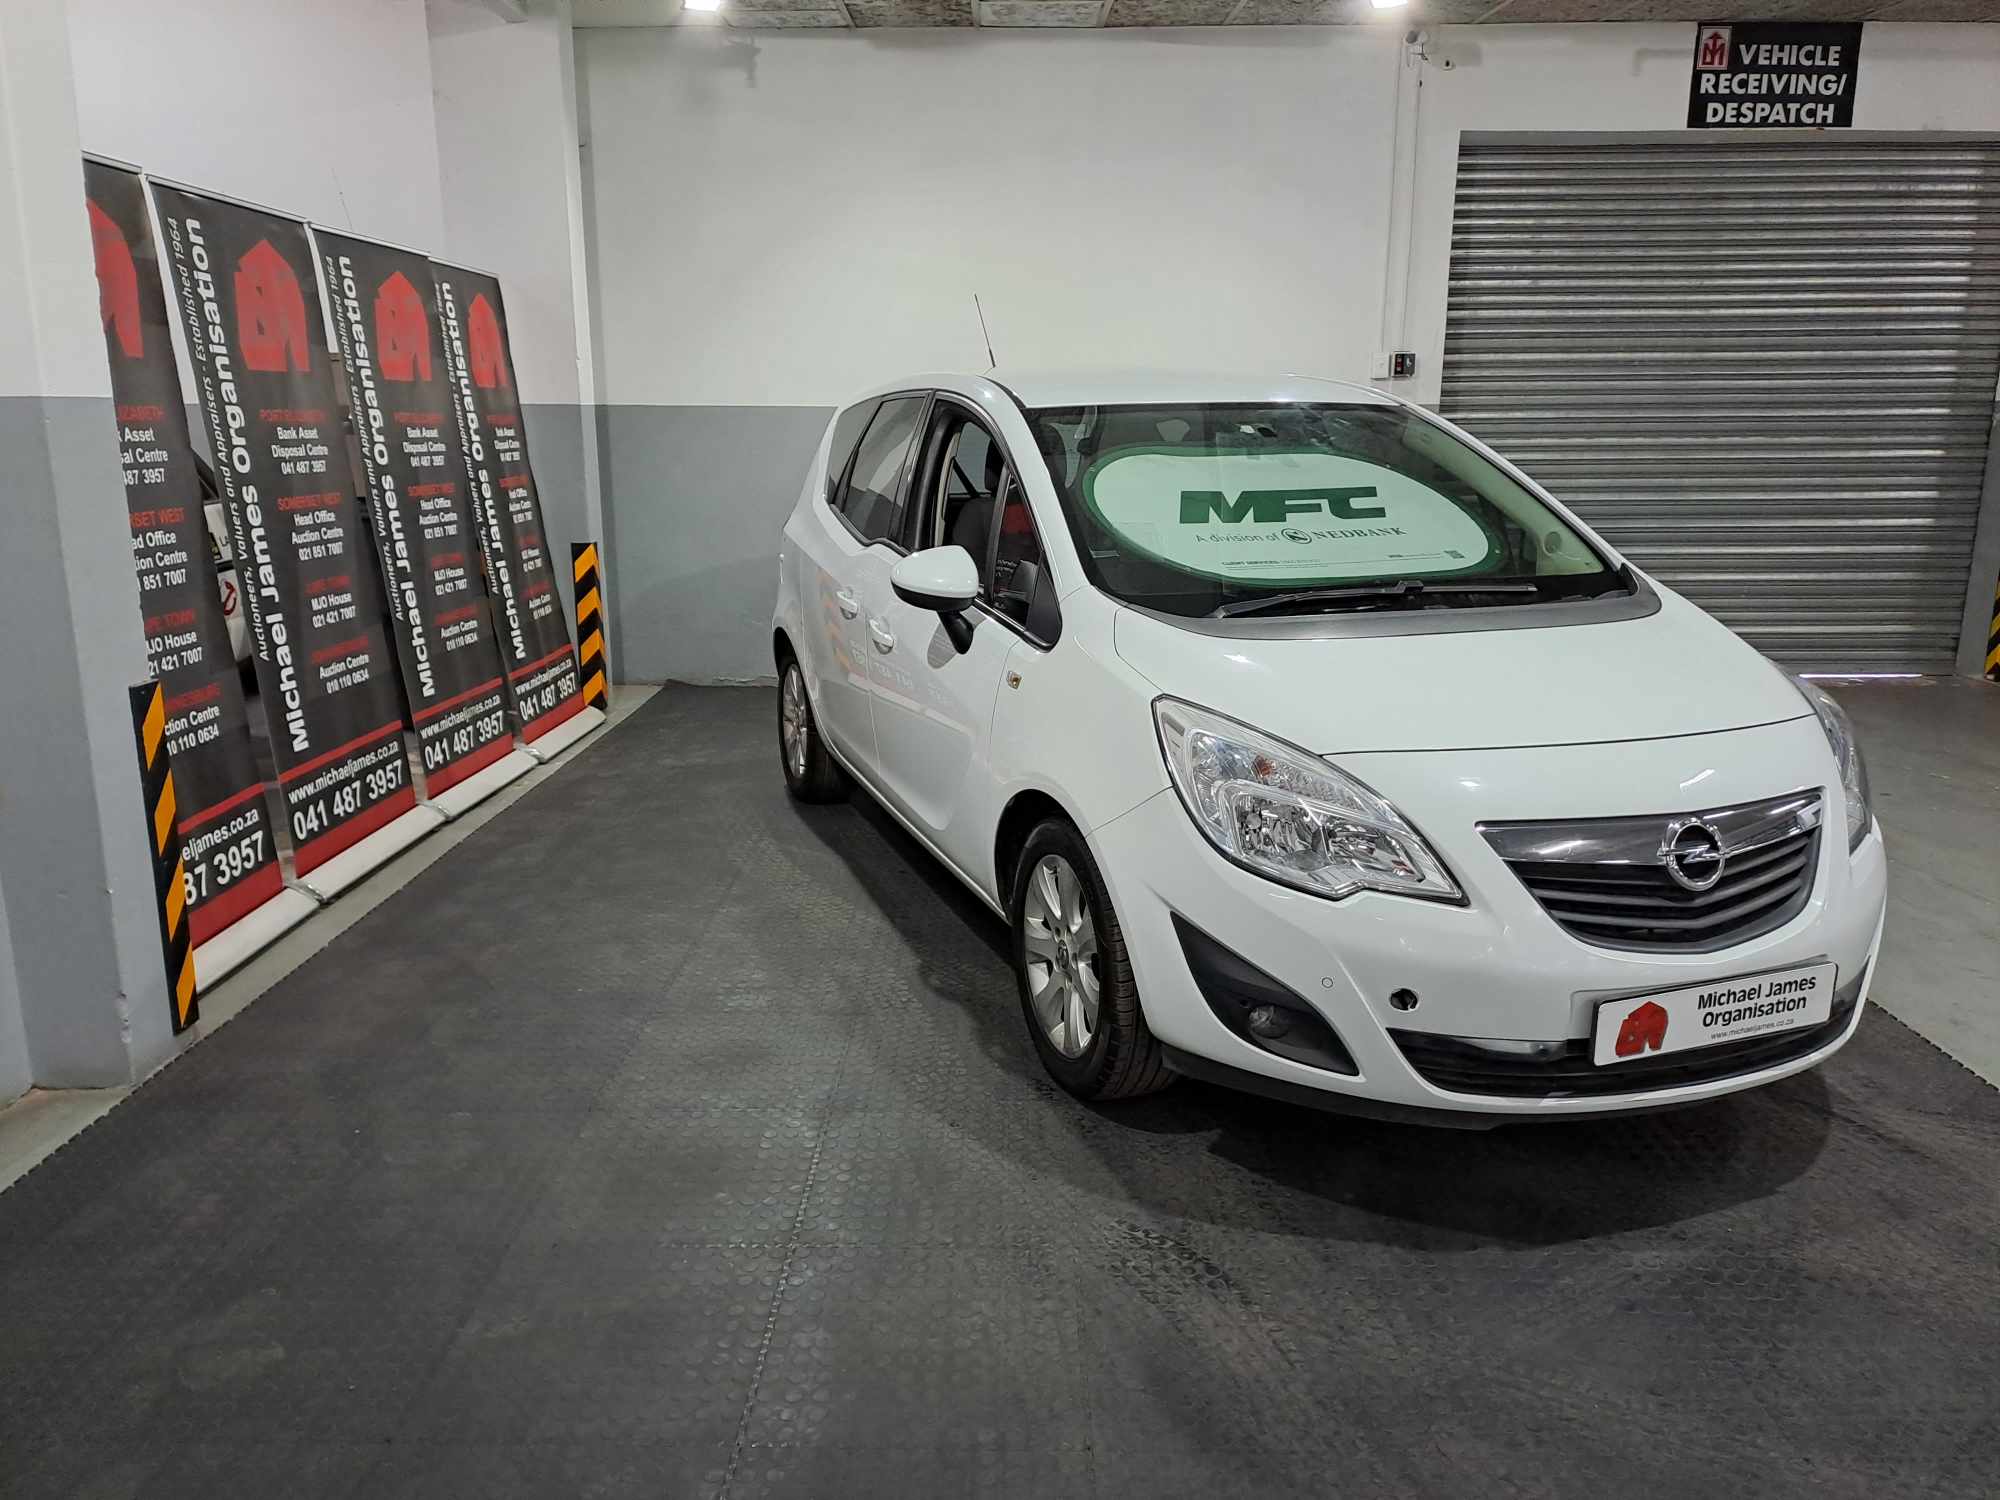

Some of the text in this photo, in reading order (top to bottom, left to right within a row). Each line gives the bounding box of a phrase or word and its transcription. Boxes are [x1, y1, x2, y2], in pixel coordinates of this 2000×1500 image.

[1739, 44, 1842, 66] VEHICLE
[1700, 73, 1847, 96] RECEIVING/
[1706, 102, 1834, 124] DESPATCH
[167, 216, 185, 260] 1964
[325, 255, 339, 290] 1964
[176, 263, 208, 361] Established
[332, 292, 355, 374] Established
[441, 282, 484, 462] Organisation
[124, 426, 155, 442] Asset
[202, 376, 229, 462] Appraisers
[277, 426, 319, 440] Bank Asset
[351, 383, 372, 457] Appraisers
[136, 447, 168, 463] Centre
[271, 443, 329, 459] Disposal Centre
[142, 467, 165, 484] 3957
[219, 465, 236, 498] and
[281, 461, 295, 476] 041
[296, 461, 310, 474] 487
[338, 256, 435, 698] Michael James Organisation
[363, 458, 377, 486] and
[185, 218, 311, 753] Michael James Organisation
[294, 510, 337, 527] Head Office
[371, 488, 387, 538] Valuers
[478, 469, 504, 553] James
[1179, 486, 1386, 524] MFC
[146, 530, 177, 546] Office
[229, 502, 248, 560] Valuers
[291, 527, 344, 545] Auction Centre
[1195, 527, 1408, 543] A division of NEDBANK
[156, 550, 188, 566] Centre
[299, 547, 313, 561] 021
[313, 545, 326, 558] 851
[143, 573, 162, 590] 851
[164, 568, 187, 587] 7007
[243, 566, 270, 662] Auctioneers,
[311, 592, 352, 611] MJO House
[495, 559, 527, 660] Michael
[312, 614, 326, 629] 021
[326, 611, 340, 625] 421
[165, 630, 197, 649] House
[161, 653, 179, 671] 421
[181, 646, 203, 666] 7007
[319, 660, 346, 680] Auction
[519, 671, 577, 721] 041 487 3957
[189, 704, 220, 726] Centre
[420, 693, 501, 740] www.michaeljames.co.za
[178, 731, 196, 751] 110
[197, 723, 220, 744] 0634
[424, 710, 504, 770] 041 487 3957
[287, 740, 399, 805] www.michaeljames.co.za
[293, 759, 403, 841] 041 487 3957
[213, 829, 264, 886] 3957
[1697, 975, 1817, 1011] Michael James
[1702, 996, 1807, 1028] Organisation
